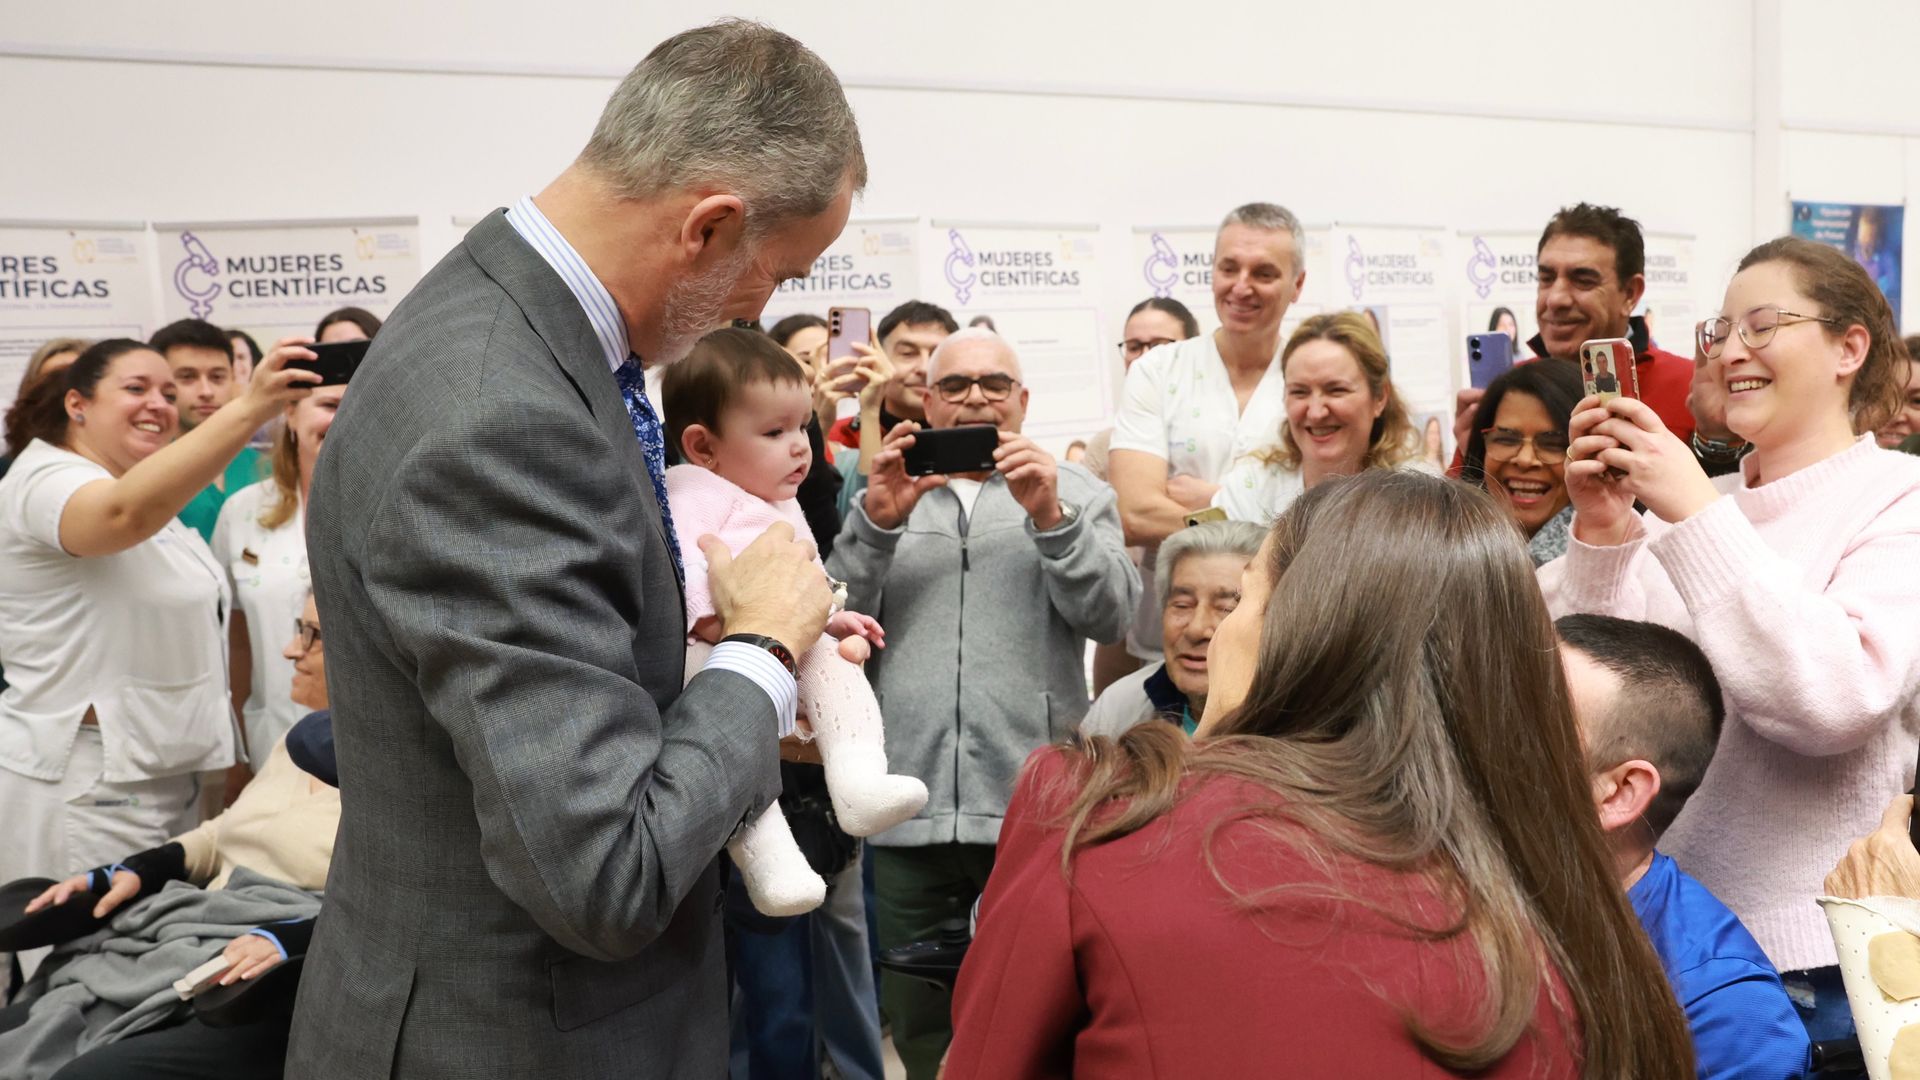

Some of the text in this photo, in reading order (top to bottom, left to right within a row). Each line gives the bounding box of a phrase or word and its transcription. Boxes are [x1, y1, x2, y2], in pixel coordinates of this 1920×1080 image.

[226, 254, 344, 274] MUJERES
[979, 251, 1054, 267] MUJERES
[1500, 255, 1538, 267] MUJ
[980, 270, 1081, 286] CIENTÍFICAS
[228, 275, 387, 298] CIENTÍFICAS
